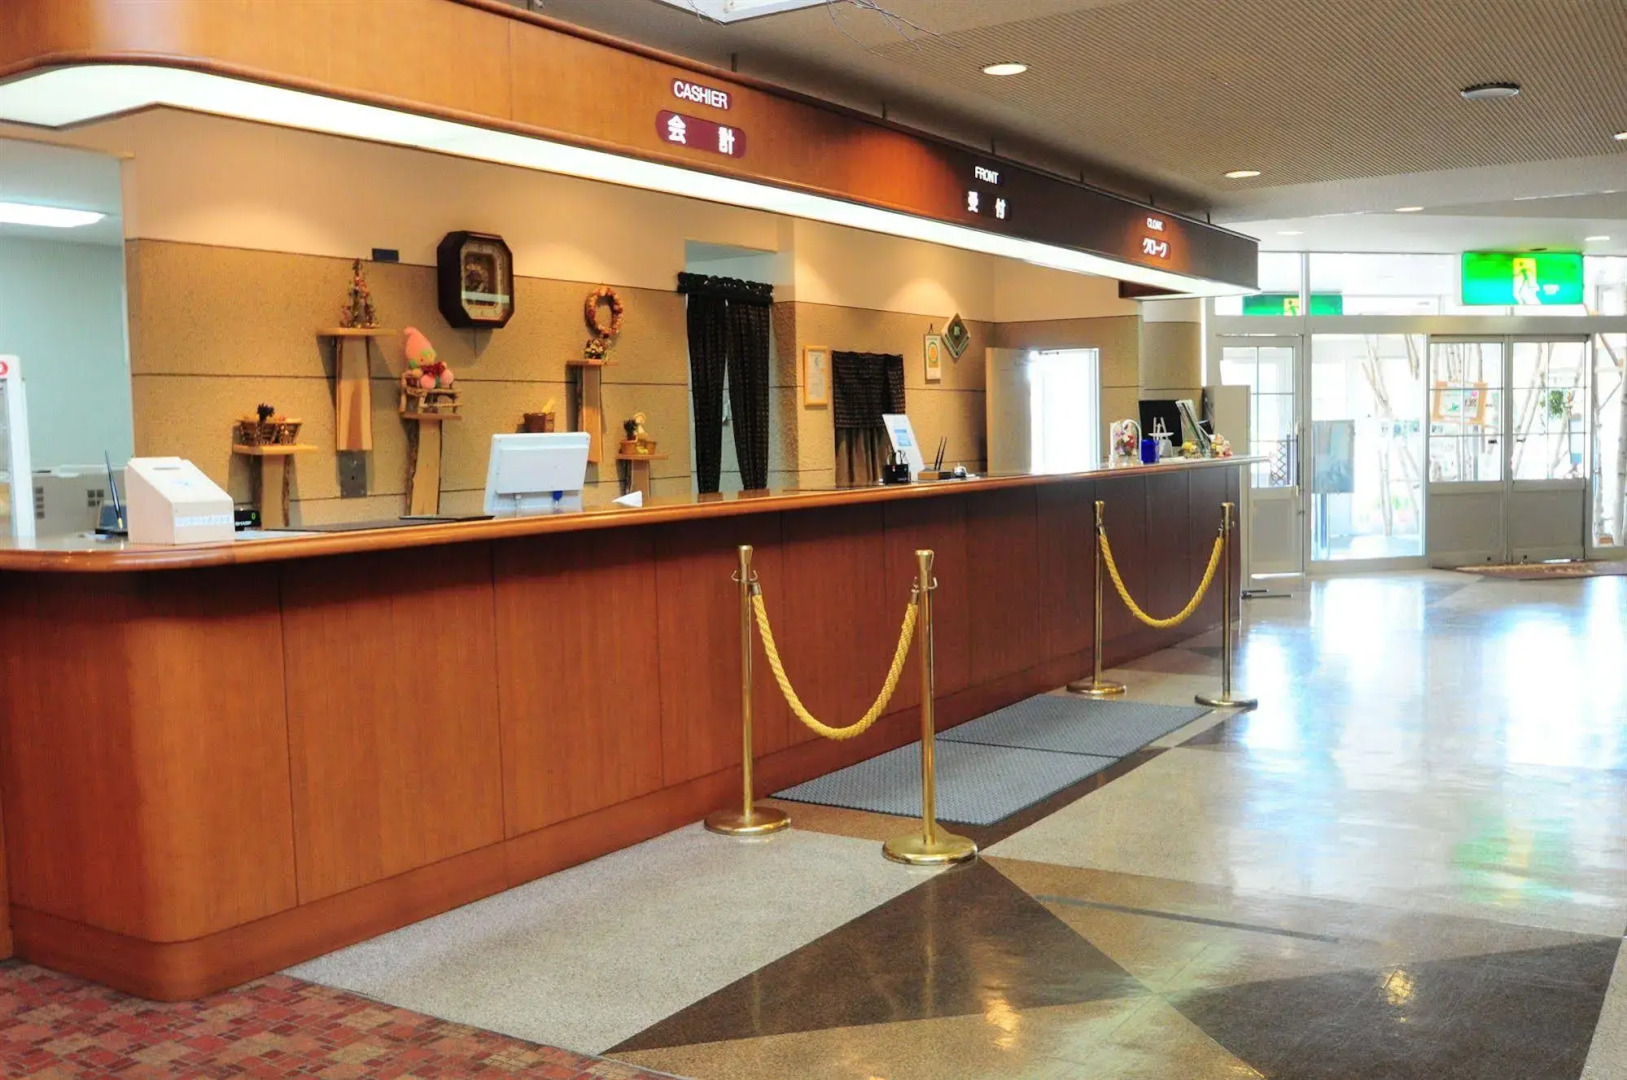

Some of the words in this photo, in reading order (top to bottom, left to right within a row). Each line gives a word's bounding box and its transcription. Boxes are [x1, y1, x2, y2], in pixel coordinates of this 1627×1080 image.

[674, 81, 728, 109] CASHIER
[975, 166, 999, 184] FRONT
[1143, 237, 1167, 258] クローク
